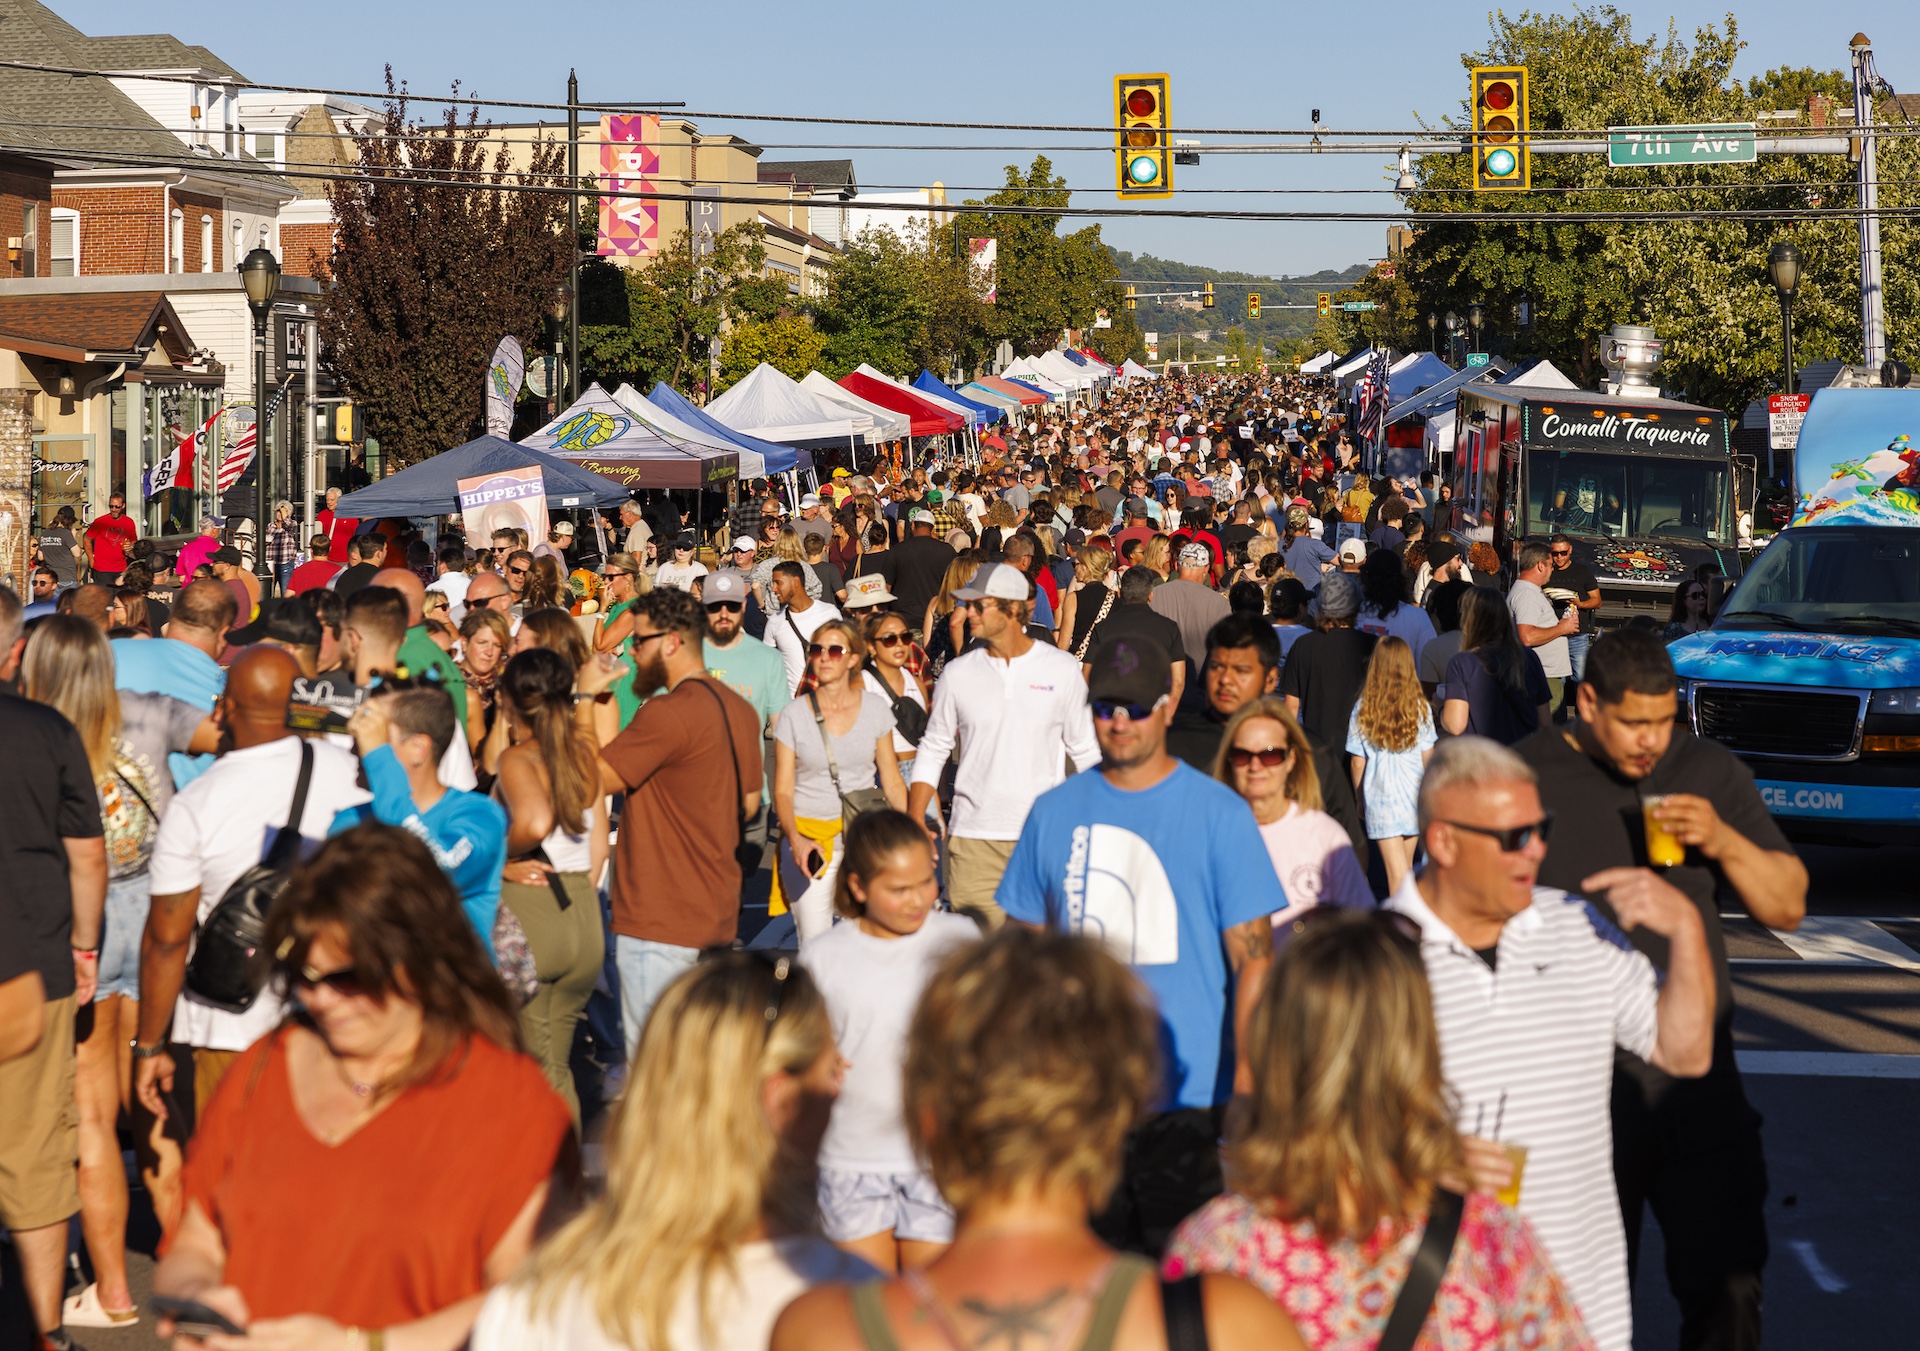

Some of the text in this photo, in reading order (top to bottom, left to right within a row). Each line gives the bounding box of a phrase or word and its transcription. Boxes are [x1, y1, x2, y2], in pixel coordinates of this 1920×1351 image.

[1625, 132, 1740, 156] 7th Ave
[617, 153, 643, 227] PLAY
[1542, 414, 1711, 447] Comalli Taqueria
[31, 459, 85, 486] Brewery
[155, 452, 173, 489] EER
[587, 461, 642, 486] Brewing
[462, 481, 543, 507] HIPPEY'S
[1705, 638, 1899, 664] KONA ICE
[1760, 787, 1844, 810] CE.COM
